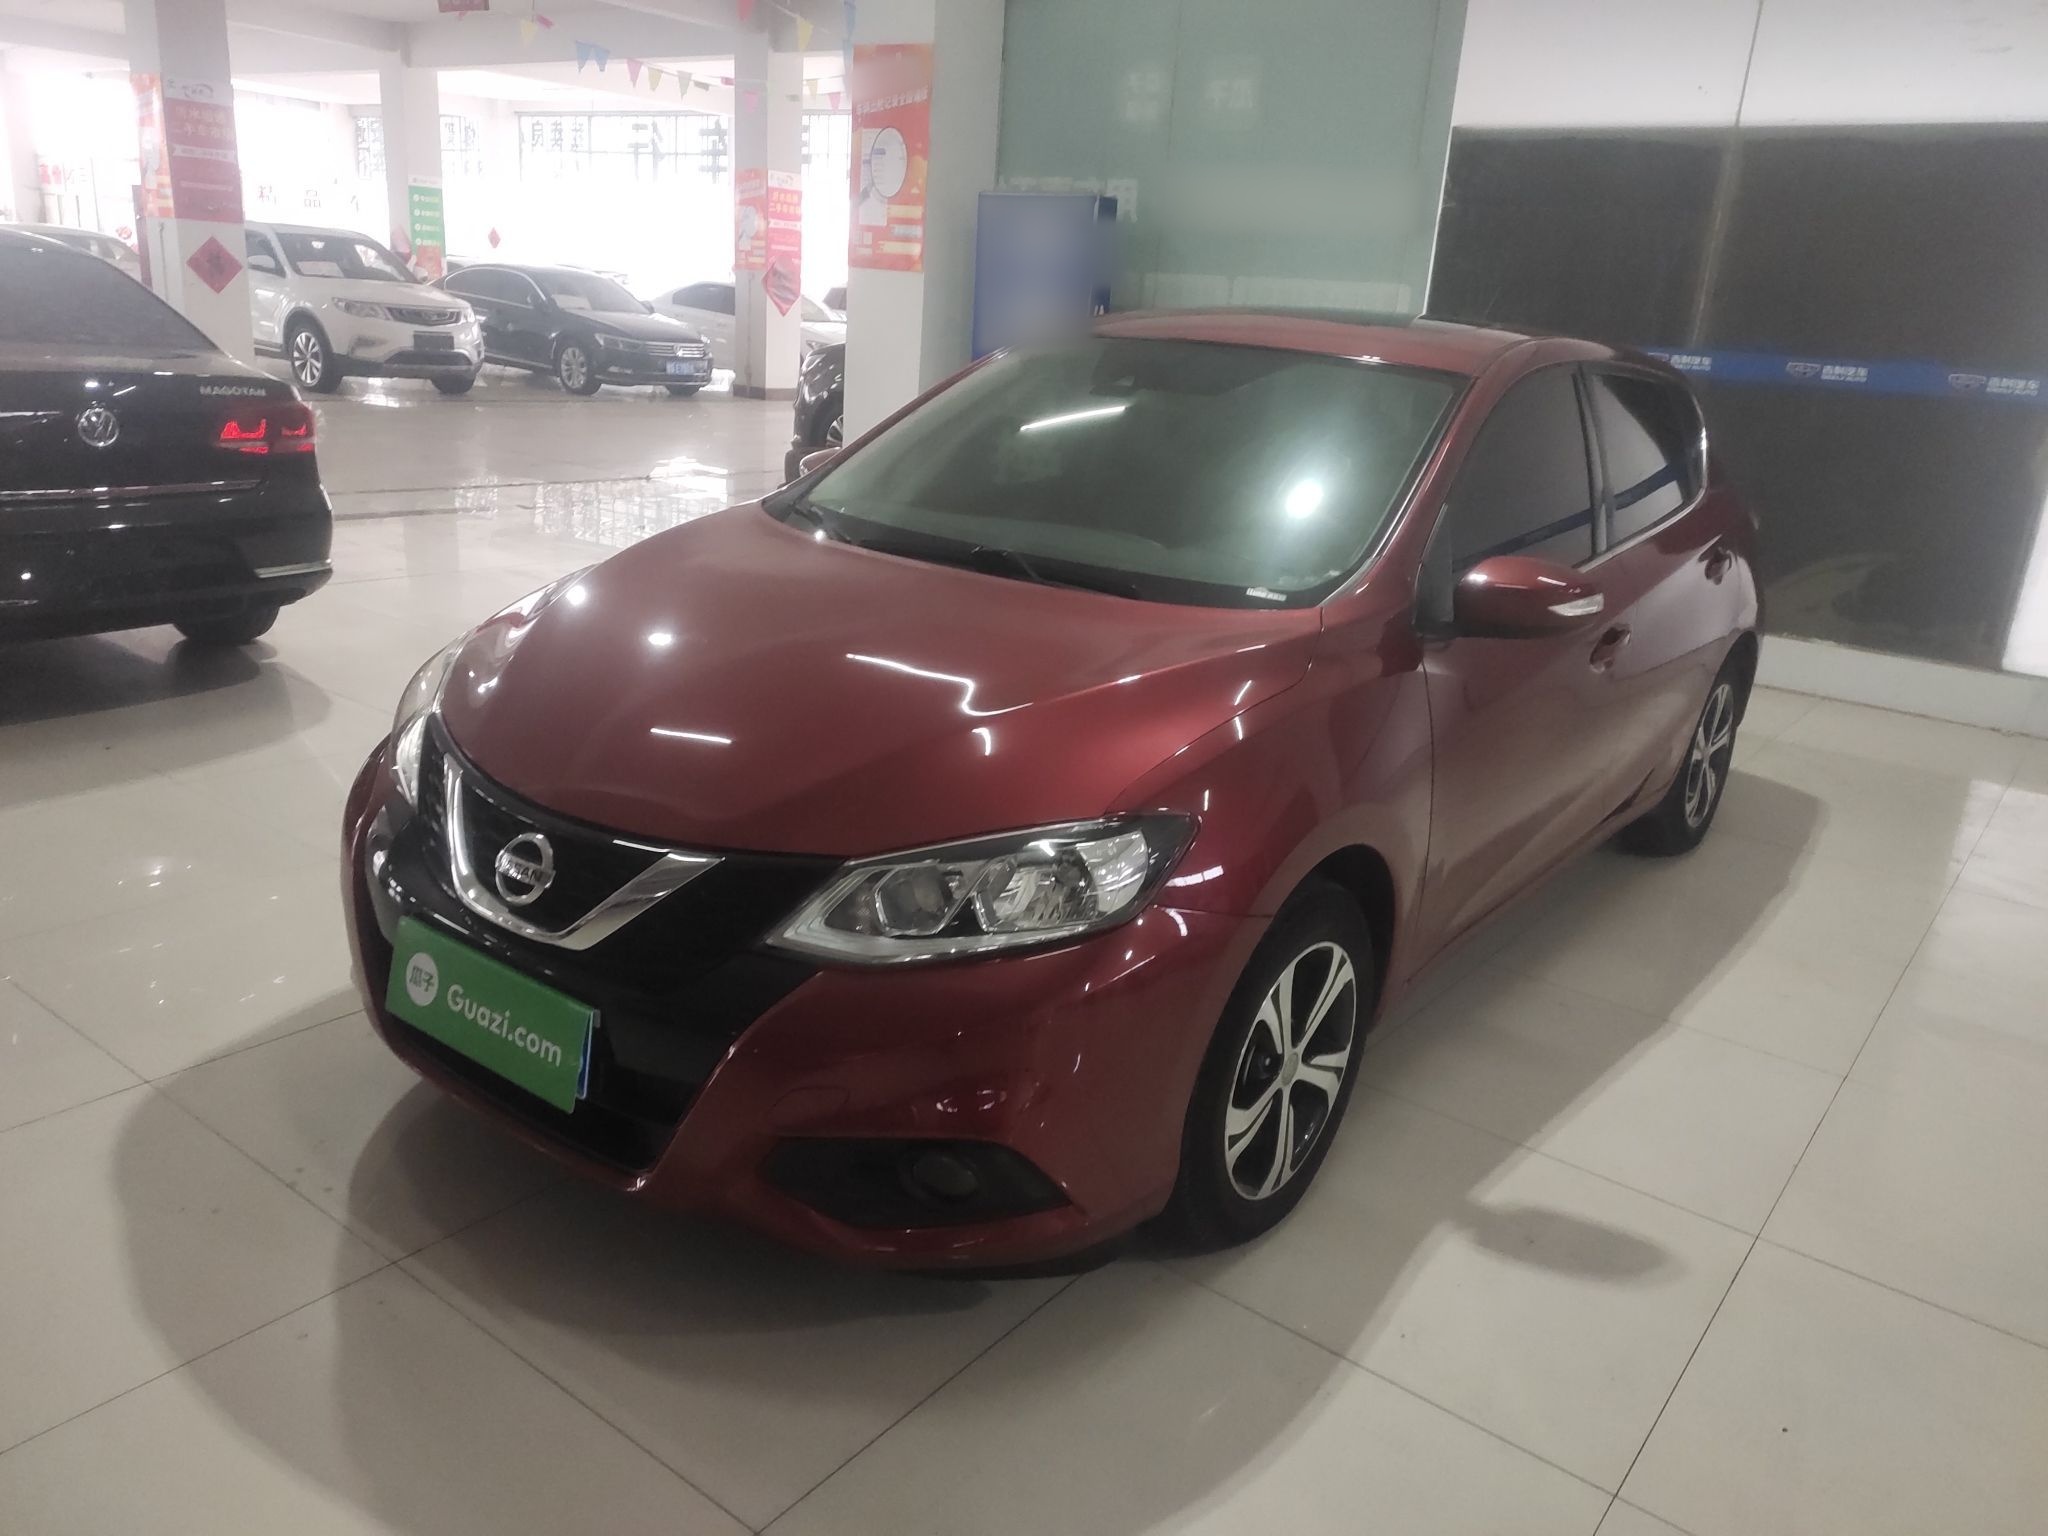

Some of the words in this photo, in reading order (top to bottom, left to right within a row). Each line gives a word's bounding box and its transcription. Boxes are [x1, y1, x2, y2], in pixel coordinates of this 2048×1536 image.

[199, 385, 267, 397] MAGOTAN
[408, 964, 435, 993] 瓜子
[447, 983, 562, 1067] Guazi.com
